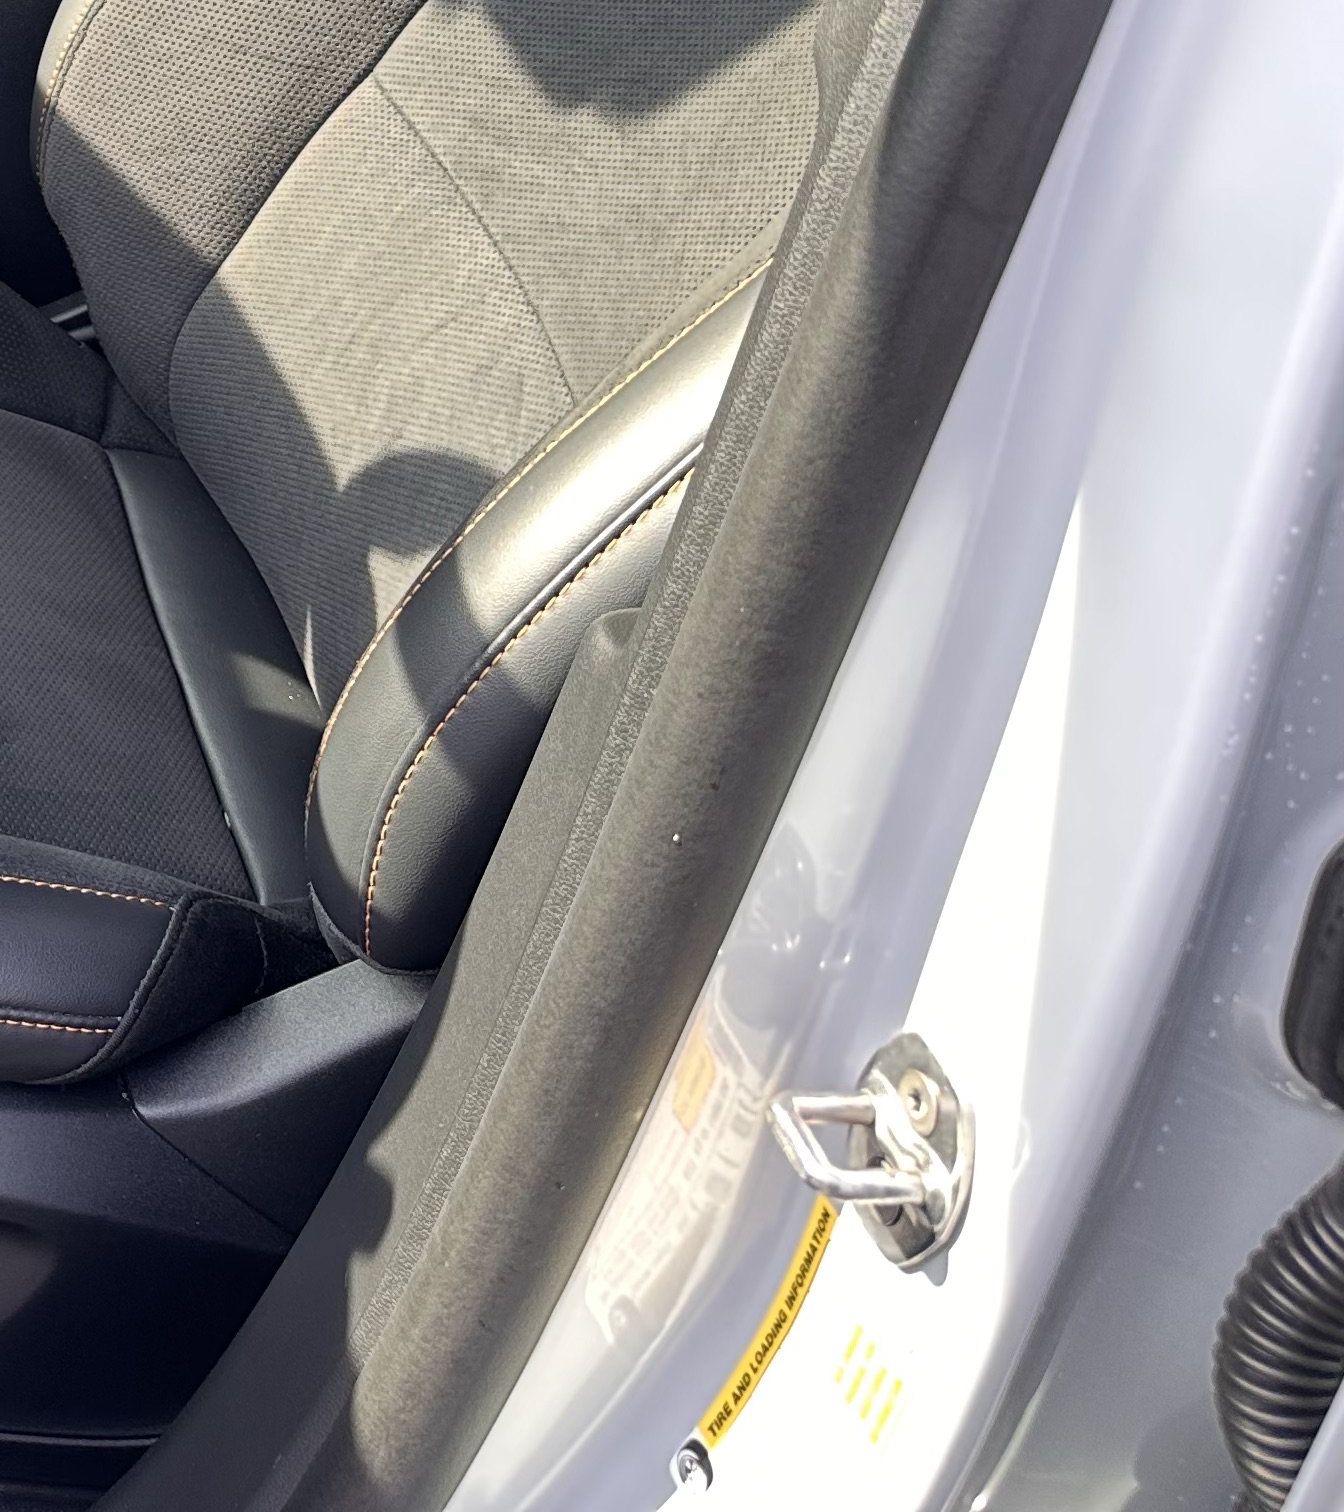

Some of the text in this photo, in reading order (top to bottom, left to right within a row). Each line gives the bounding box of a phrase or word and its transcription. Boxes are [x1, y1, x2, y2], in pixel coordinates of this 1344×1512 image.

[706, 1205, 831, 1438] TIRE AND LOADING INFORMATION
